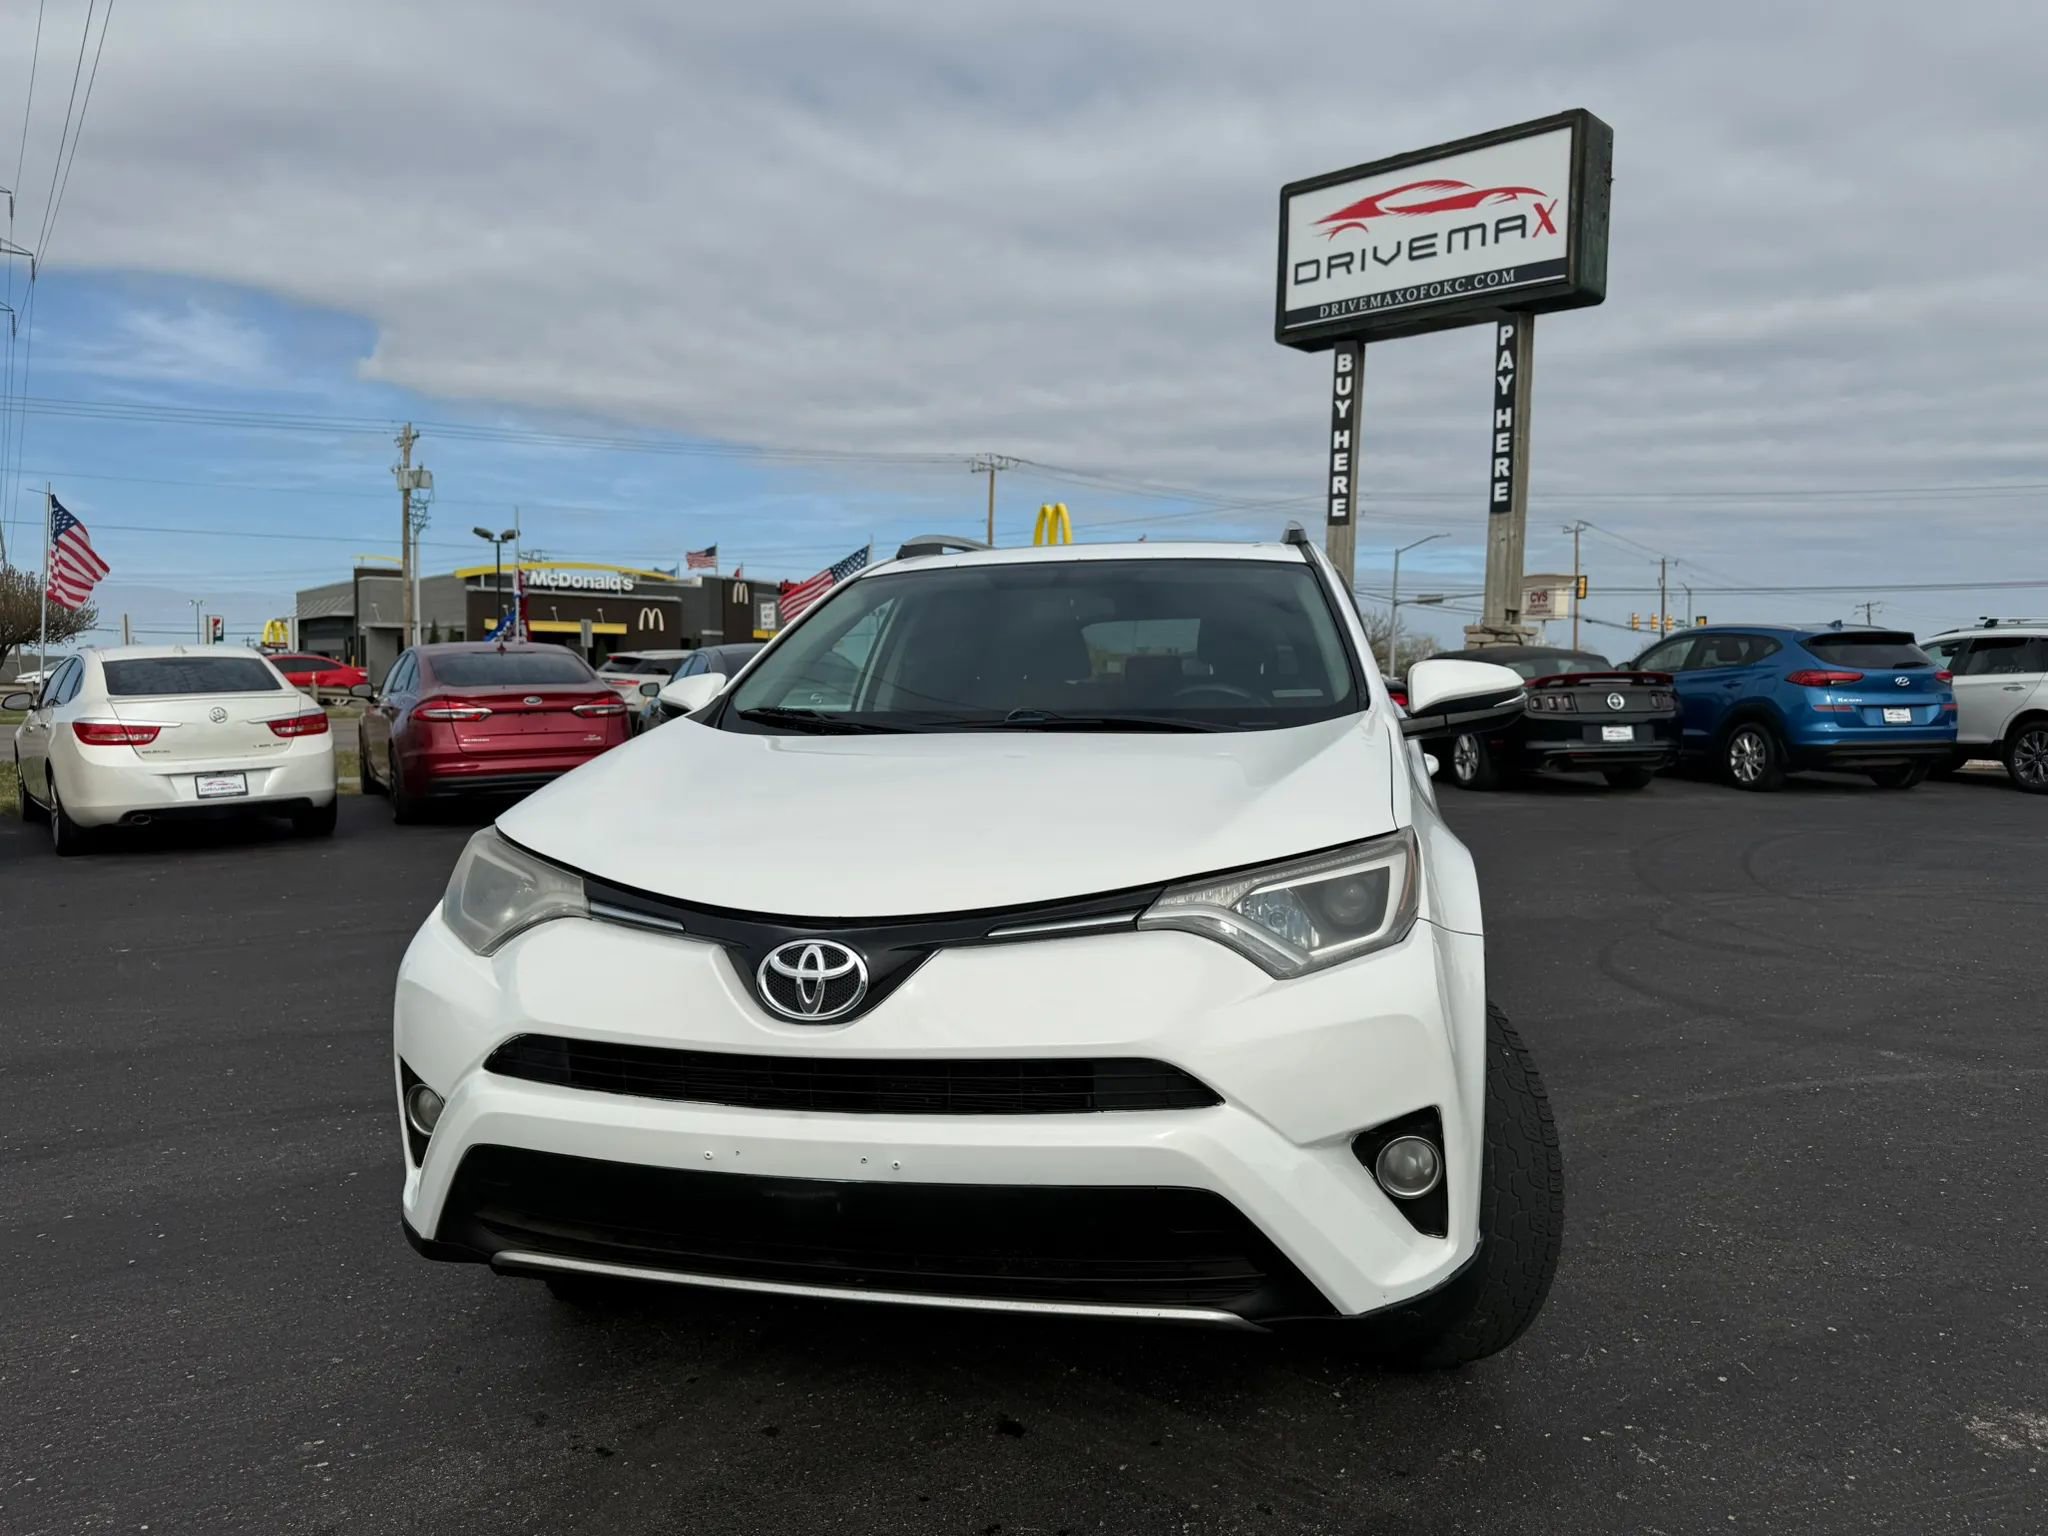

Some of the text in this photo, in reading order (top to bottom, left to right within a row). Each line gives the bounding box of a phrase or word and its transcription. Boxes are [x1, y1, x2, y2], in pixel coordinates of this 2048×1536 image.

[1293, 199, 1558, 286] DRIVEMAX
[1319, 269, 1516, 319] DRIVEMAXOFOKC.COM
[1331, 353, 1353, 517] BUY HERE
[1493, 324, 1514, 502] PAY HERE
[528, 570, 634, 591] McDonald's
[1530, 591, 1548, 603] CVS
